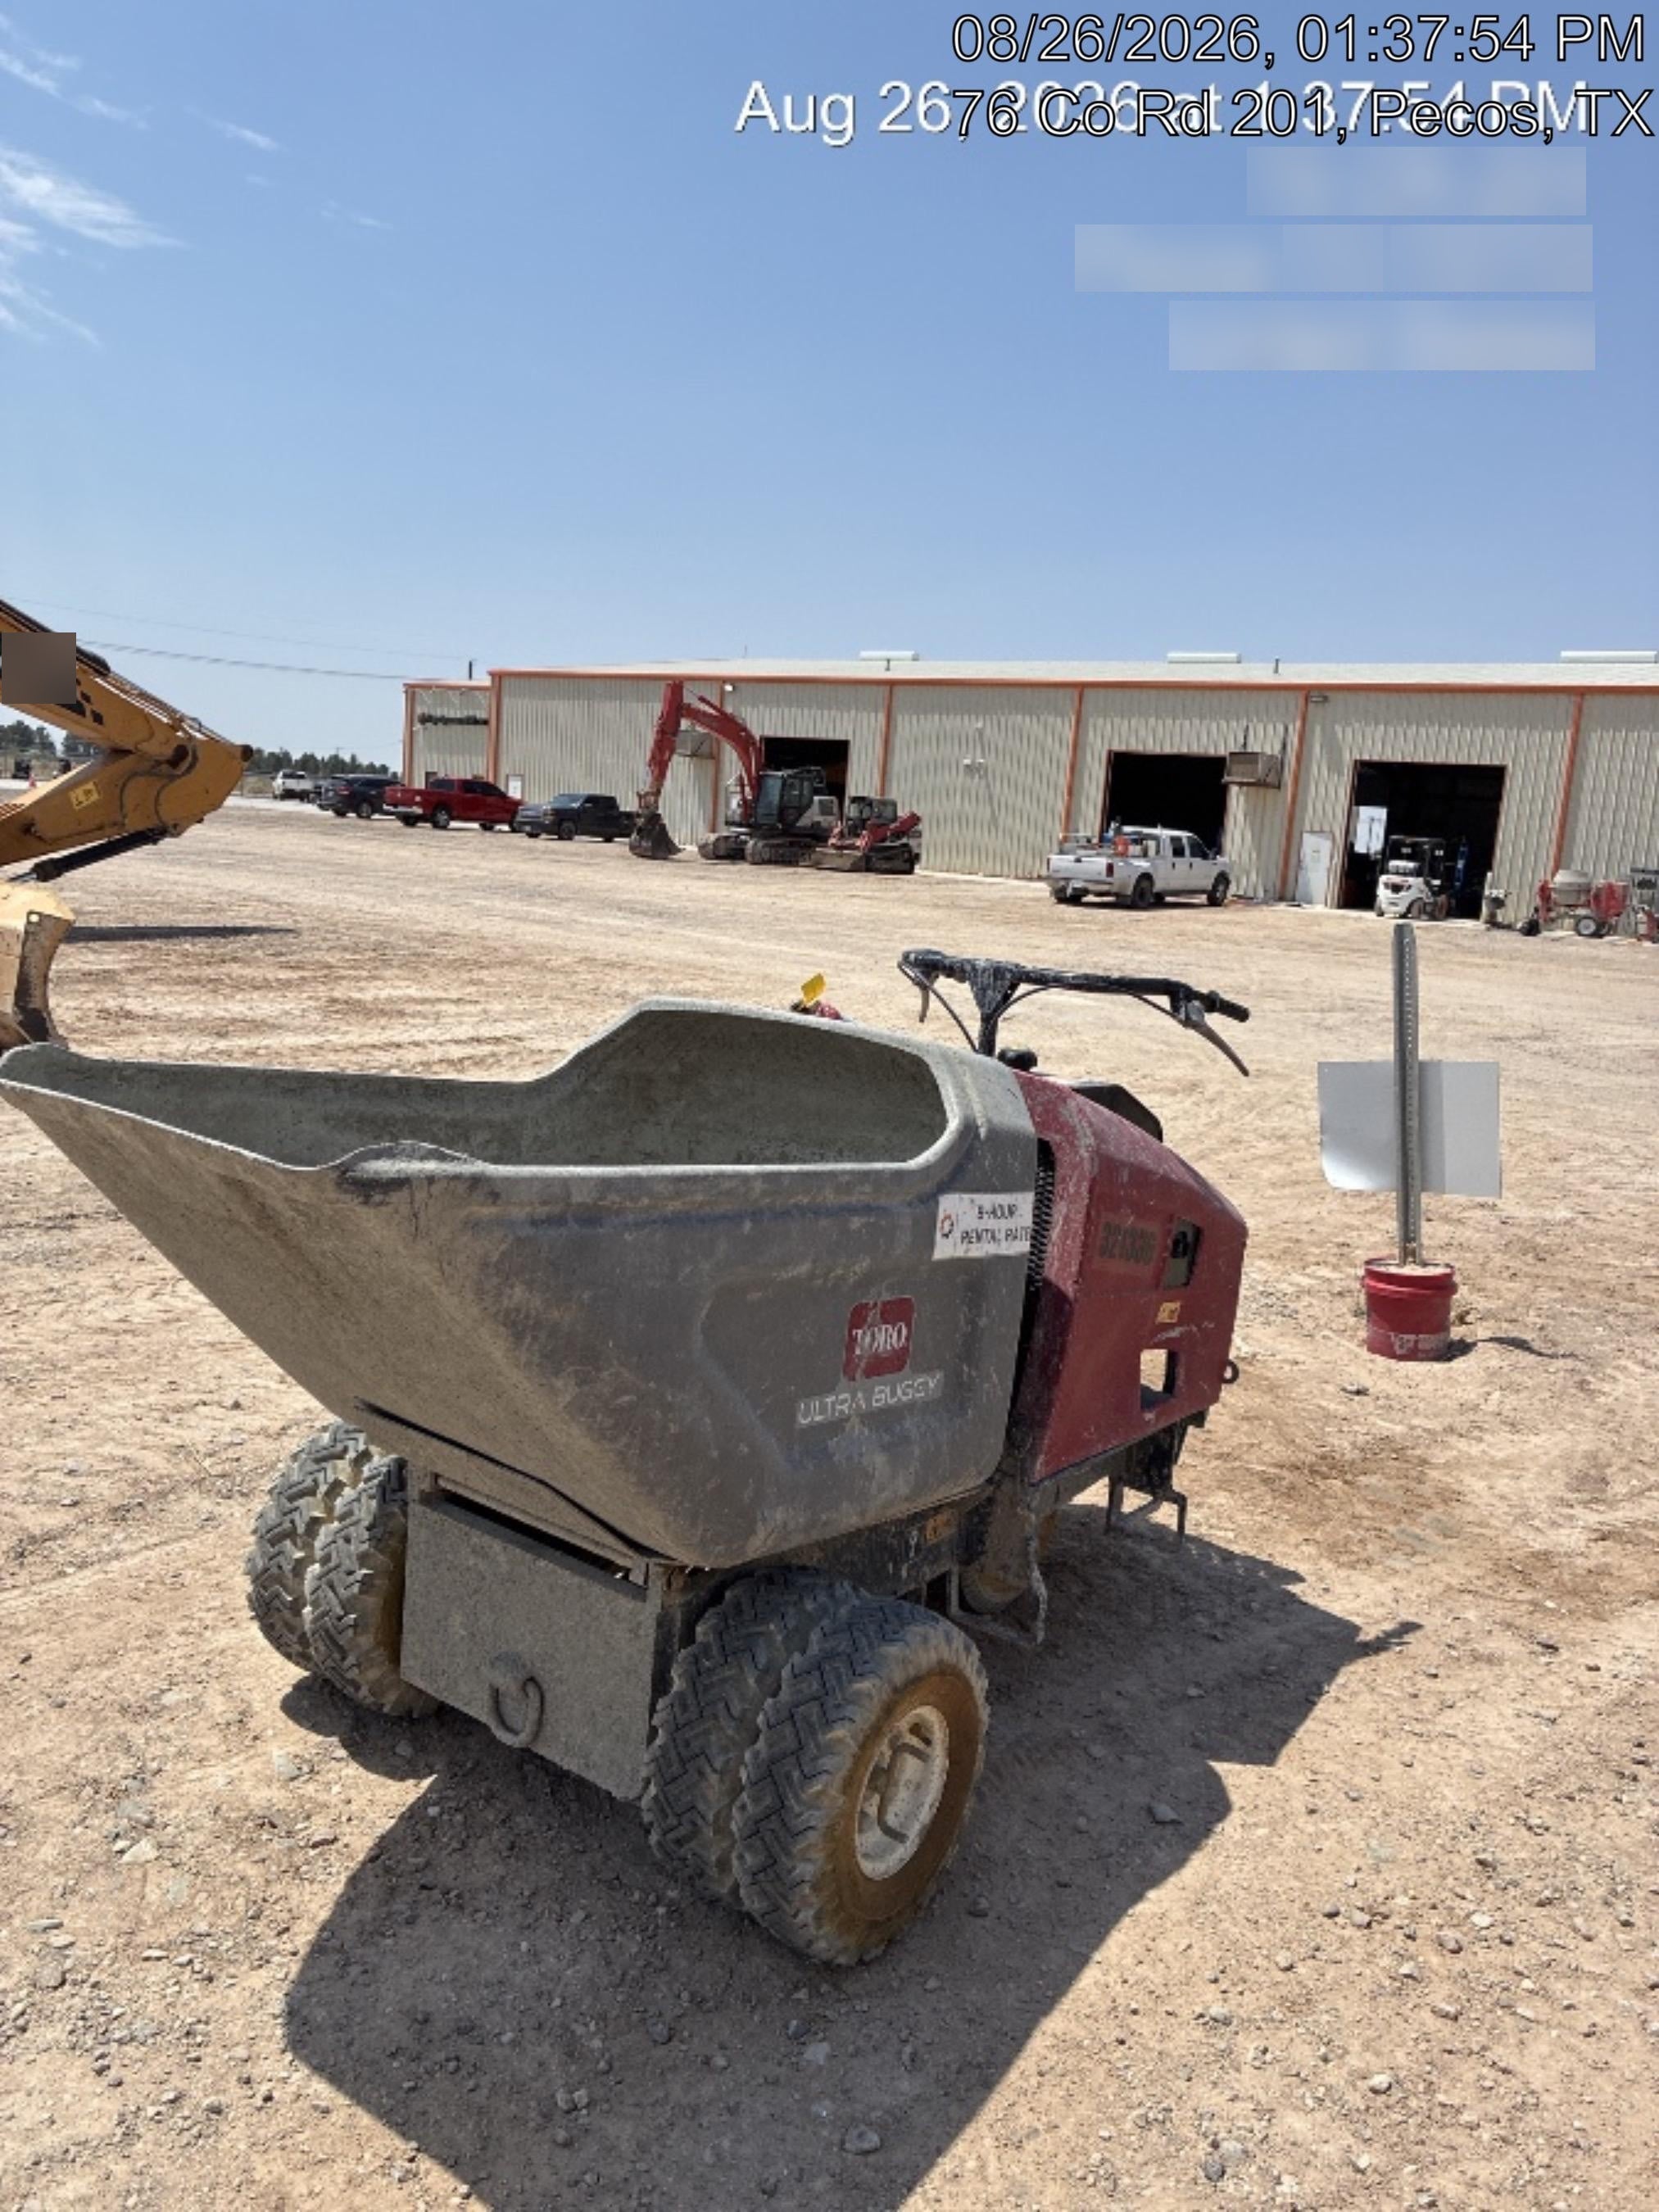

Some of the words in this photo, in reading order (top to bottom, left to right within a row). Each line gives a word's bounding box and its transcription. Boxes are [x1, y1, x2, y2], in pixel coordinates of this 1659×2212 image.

[852, 1321, 909, 1355] TORO
[798, 1390, 866, 1425] ULTRA
[872, 1372, 941, 1407] BUGGY
